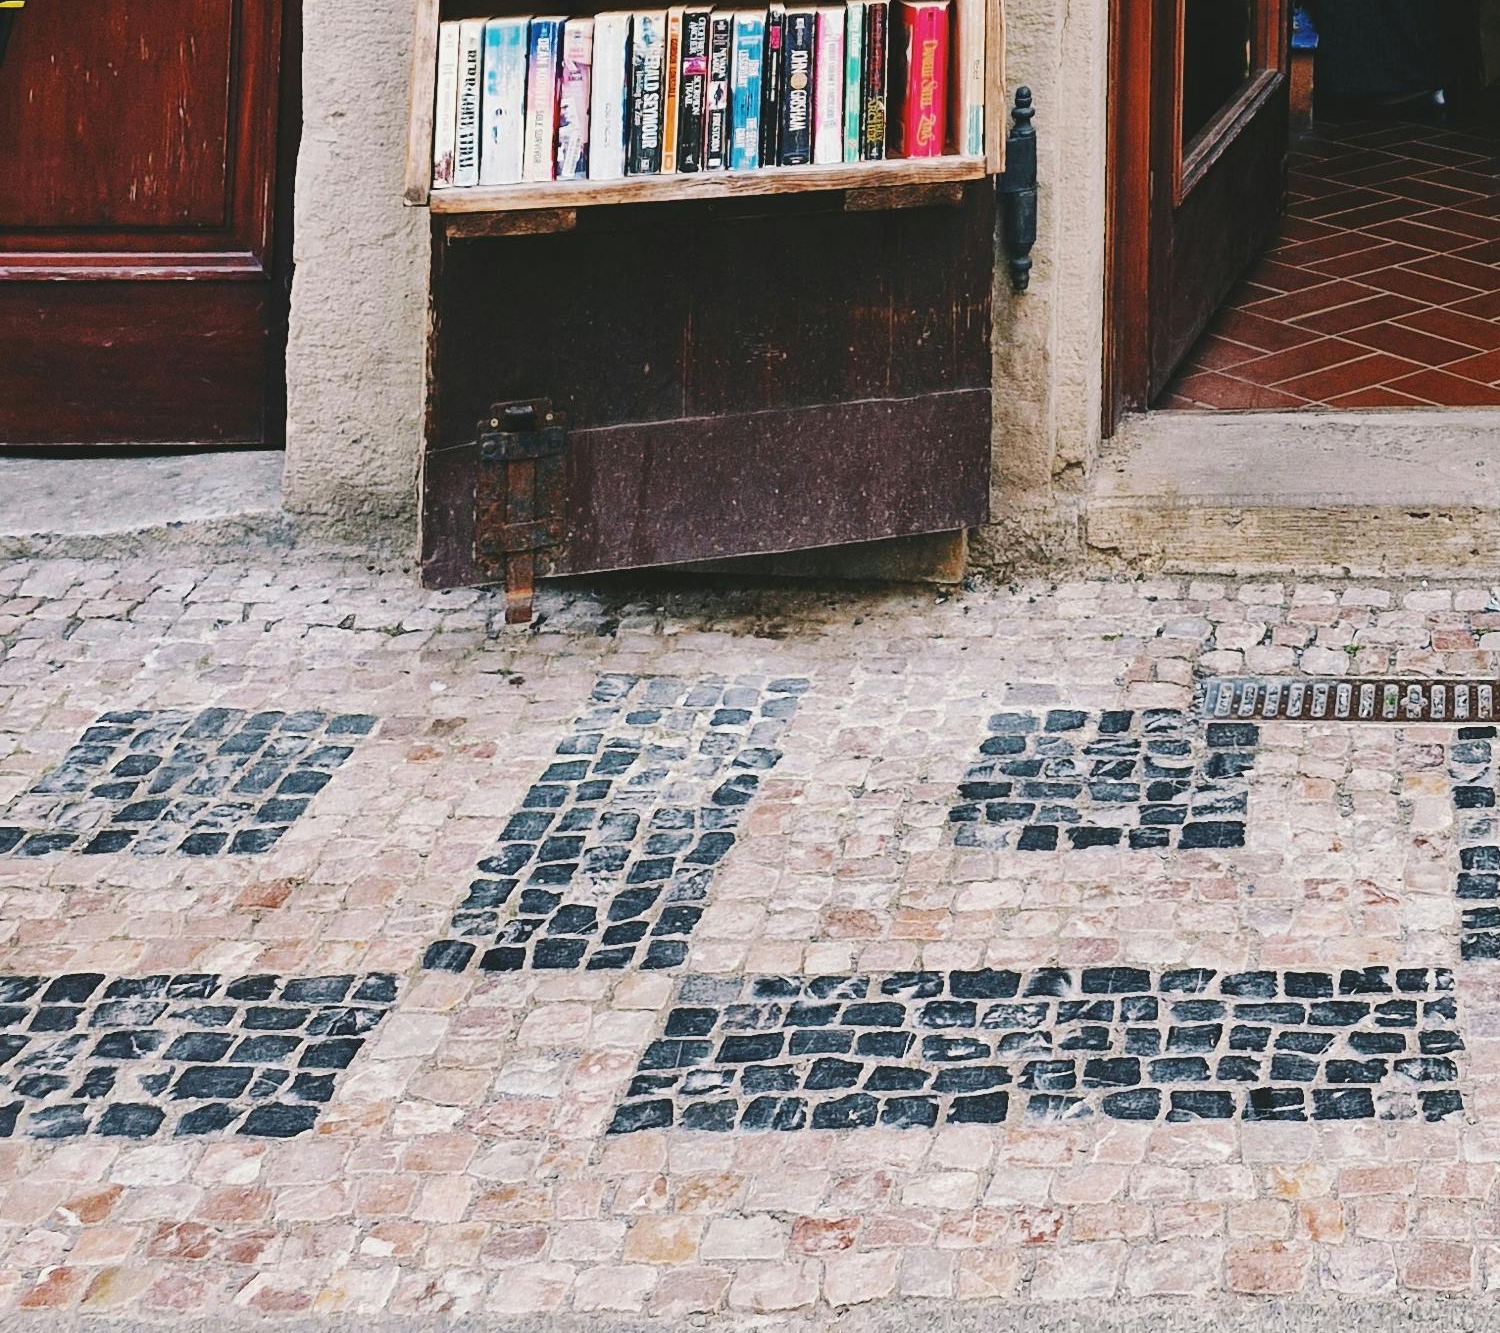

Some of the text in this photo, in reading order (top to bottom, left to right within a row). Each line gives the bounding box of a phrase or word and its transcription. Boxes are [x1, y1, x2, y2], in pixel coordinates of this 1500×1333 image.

[685, 81, 693, 107] TRAIL
[789, 50, 807, 131] JOHN GRISHAM
[641, 93, 659, 149] SEYMOUR
